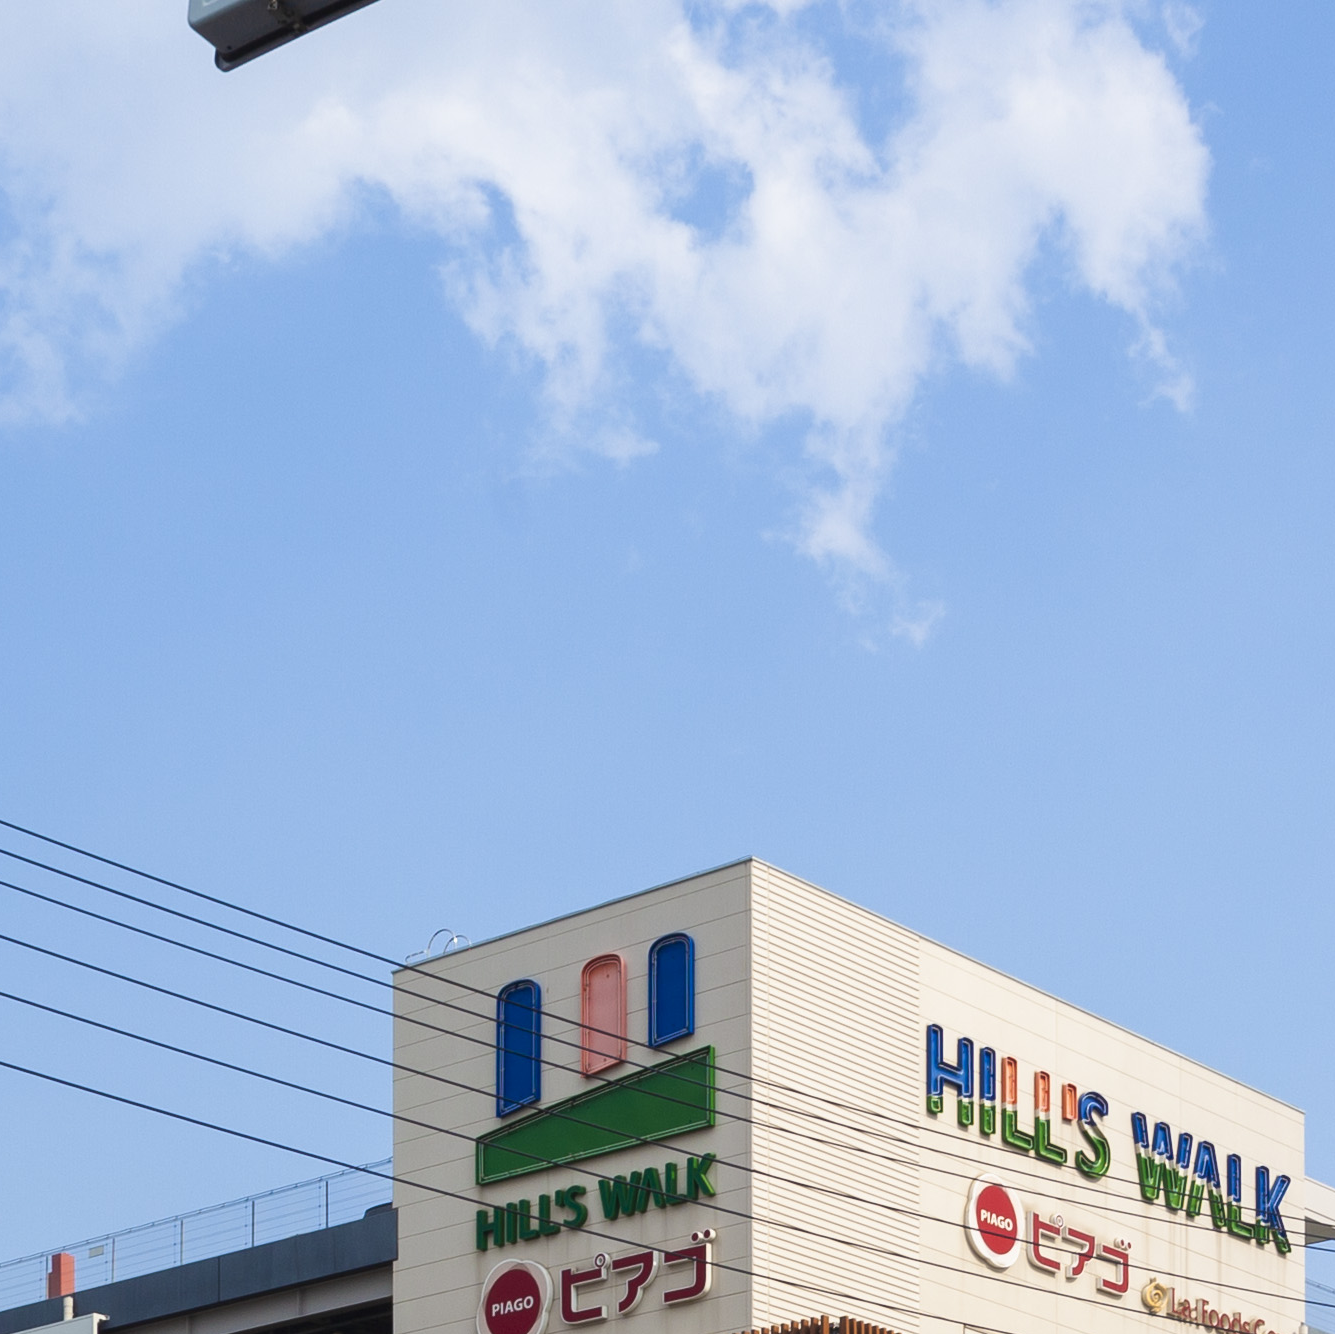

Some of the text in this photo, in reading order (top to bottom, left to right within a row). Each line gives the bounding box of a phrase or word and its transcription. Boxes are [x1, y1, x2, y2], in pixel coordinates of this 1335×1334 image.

[926, 1023, 1291, 1255] HILL'S WALK
[475, 1152, 716, 1252] HILL'S WALK
[979, 1208, 1014, 1232] PIAGO
[559, 1228, 718, 1325] ピアゴ
[1027, 1211, 1133, 1297] ピアゴ
[491, 1296, 535, 1318] PIAGO
